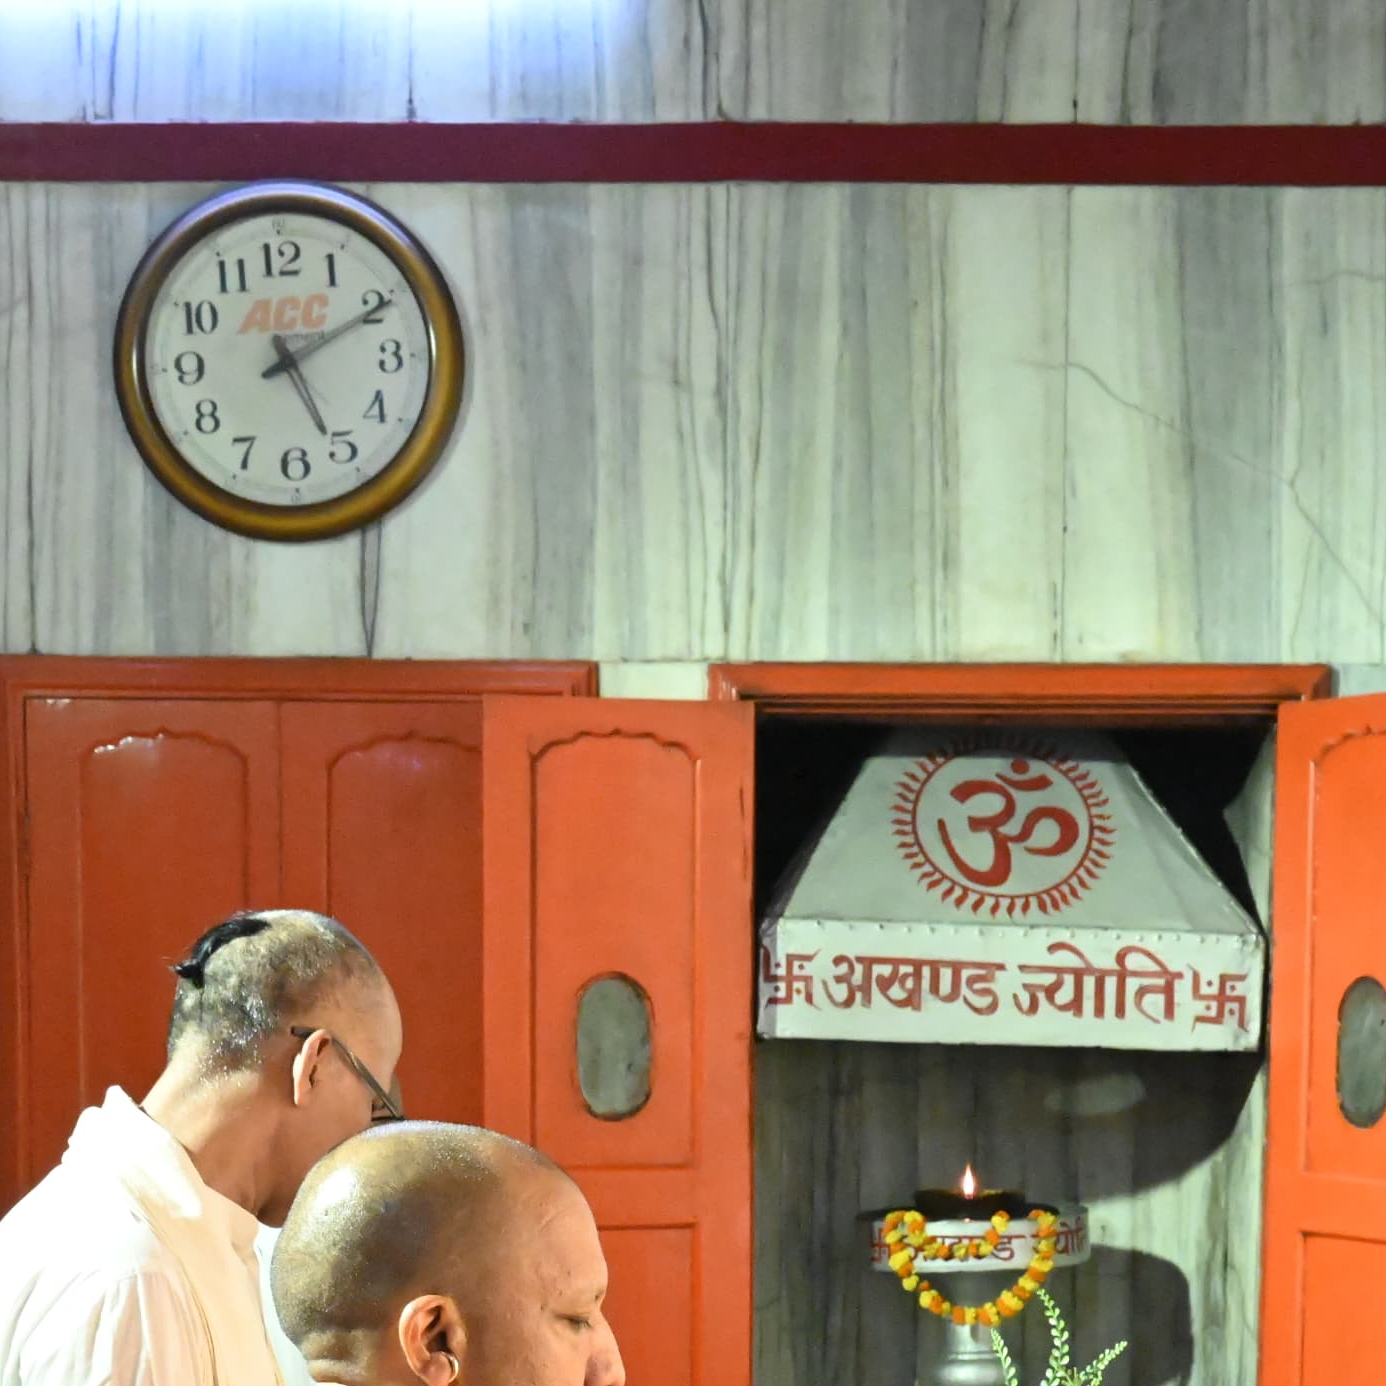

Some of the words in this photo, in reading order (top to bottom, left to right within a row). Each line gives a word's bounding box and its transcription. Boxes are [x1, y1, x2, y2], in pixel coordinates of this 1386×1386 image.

[218, 258, 250, 293] 11
[262, 240, 302, 277] 12
[323, 253, 339, 287] 1
[183, 300, 219, 335] 10
[237, 293, 330, 335] ACC
[361, 289, 385, 324] 2
[173, 351, 205, 385] 9
[378, 339, 404, 373] 3
[194, 399, 221, 434] 8
[362, 389, 387, 424] 4
[231, 435, 256, 470] 7
[280, 447, 312, 481] 6
[328, 430, 358, 464] 5
[821, 953, 1008, 1016] अखण्ड
[1013, 941, 1184, 1024] ज्योति
